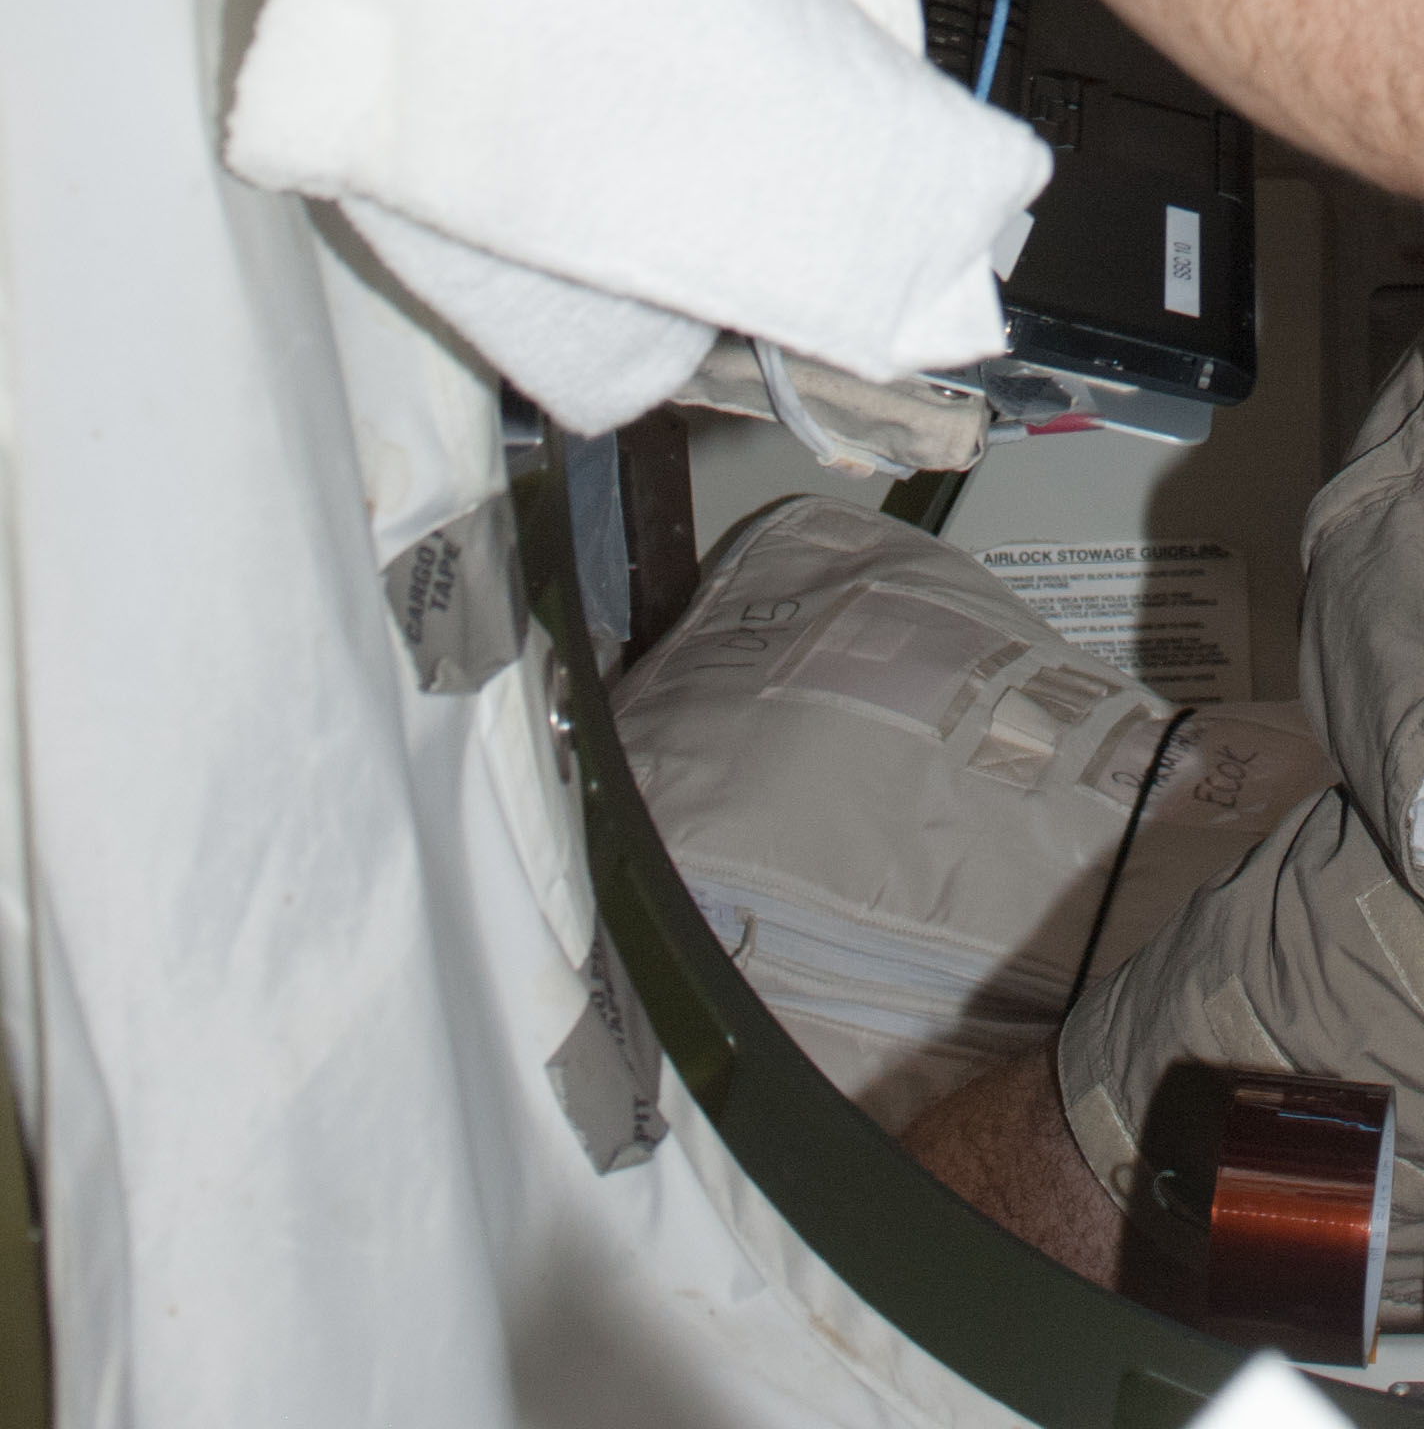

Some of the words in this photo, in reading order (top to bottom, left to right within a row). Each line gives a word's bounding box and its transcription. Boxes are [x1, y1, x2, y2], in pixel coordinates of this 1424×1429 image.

[1173, 241, 1192, 255] 10
[1173, 256, 1192, 281] SSC
[983, 550, 1052, 566] AIRLOCK
[1056, 546, 1136, 563] STOWAGE
[429, 540, 463, 613] TAPE
